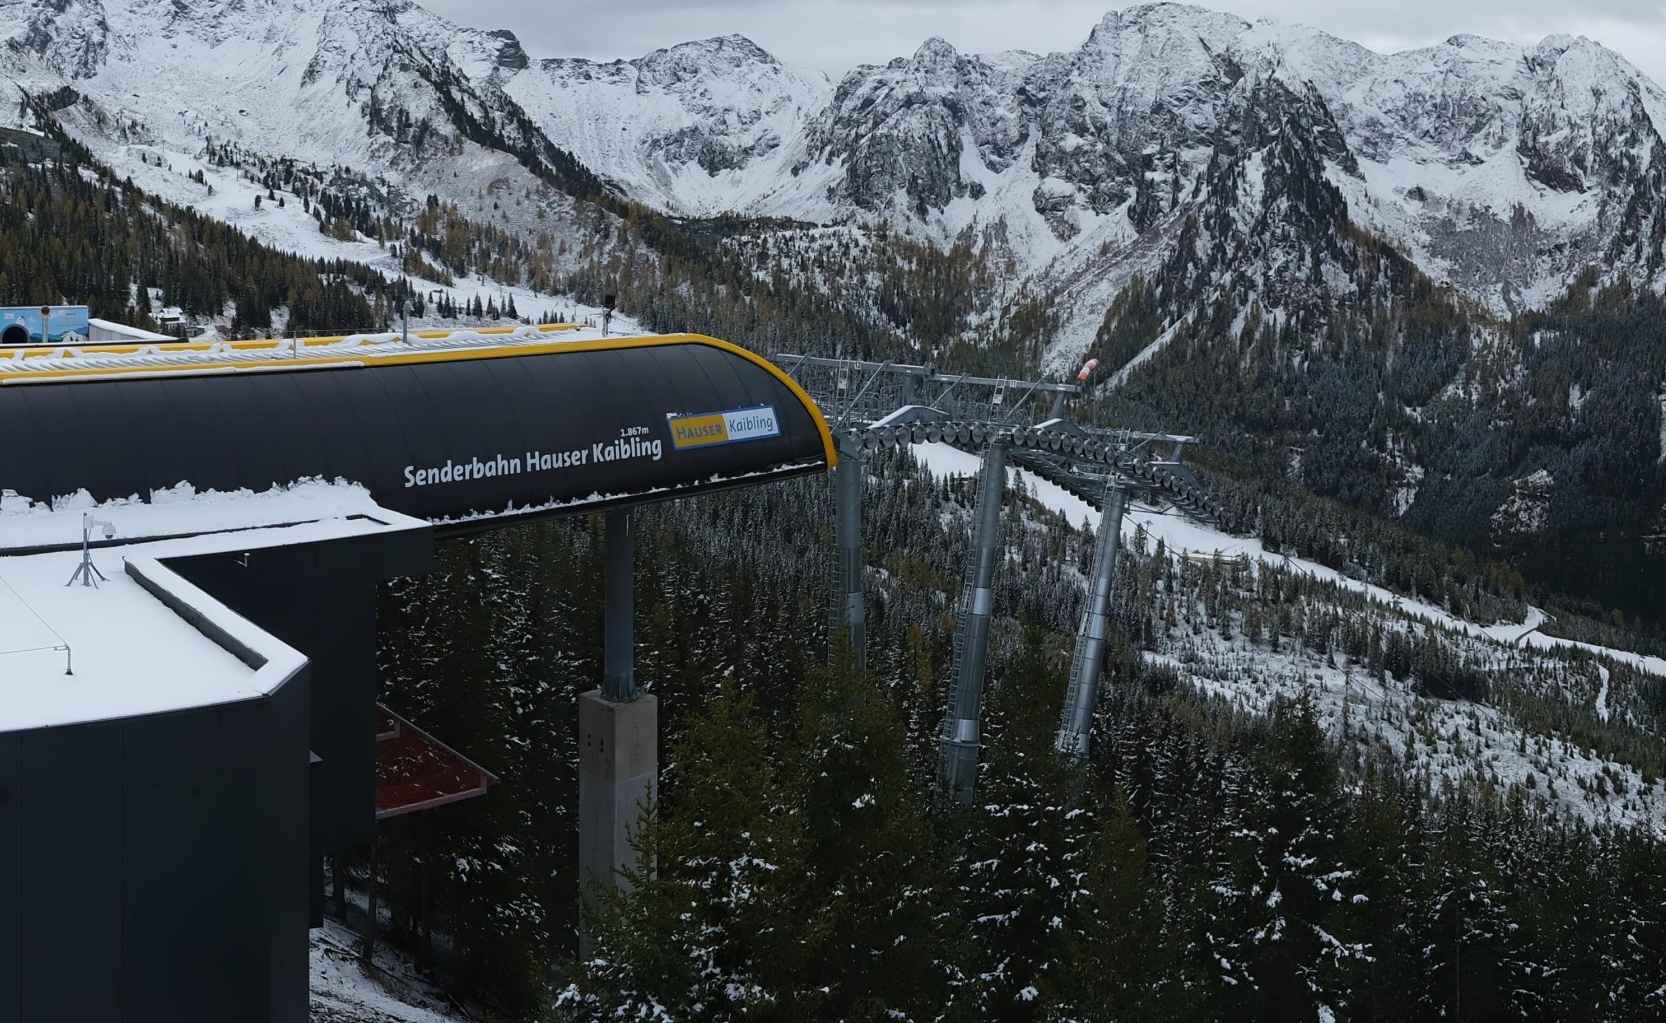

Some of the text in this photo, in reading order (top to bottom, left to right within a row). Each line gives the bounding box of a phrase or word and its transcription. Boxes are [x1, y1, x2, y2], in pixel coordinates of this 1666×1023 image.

[620, 426, 649, 437] 1.867m
[675, 415, 773, 440] HAUSER Kaibling
[404, 436, 662, 488] Senderbahn Hauser Kaibling
